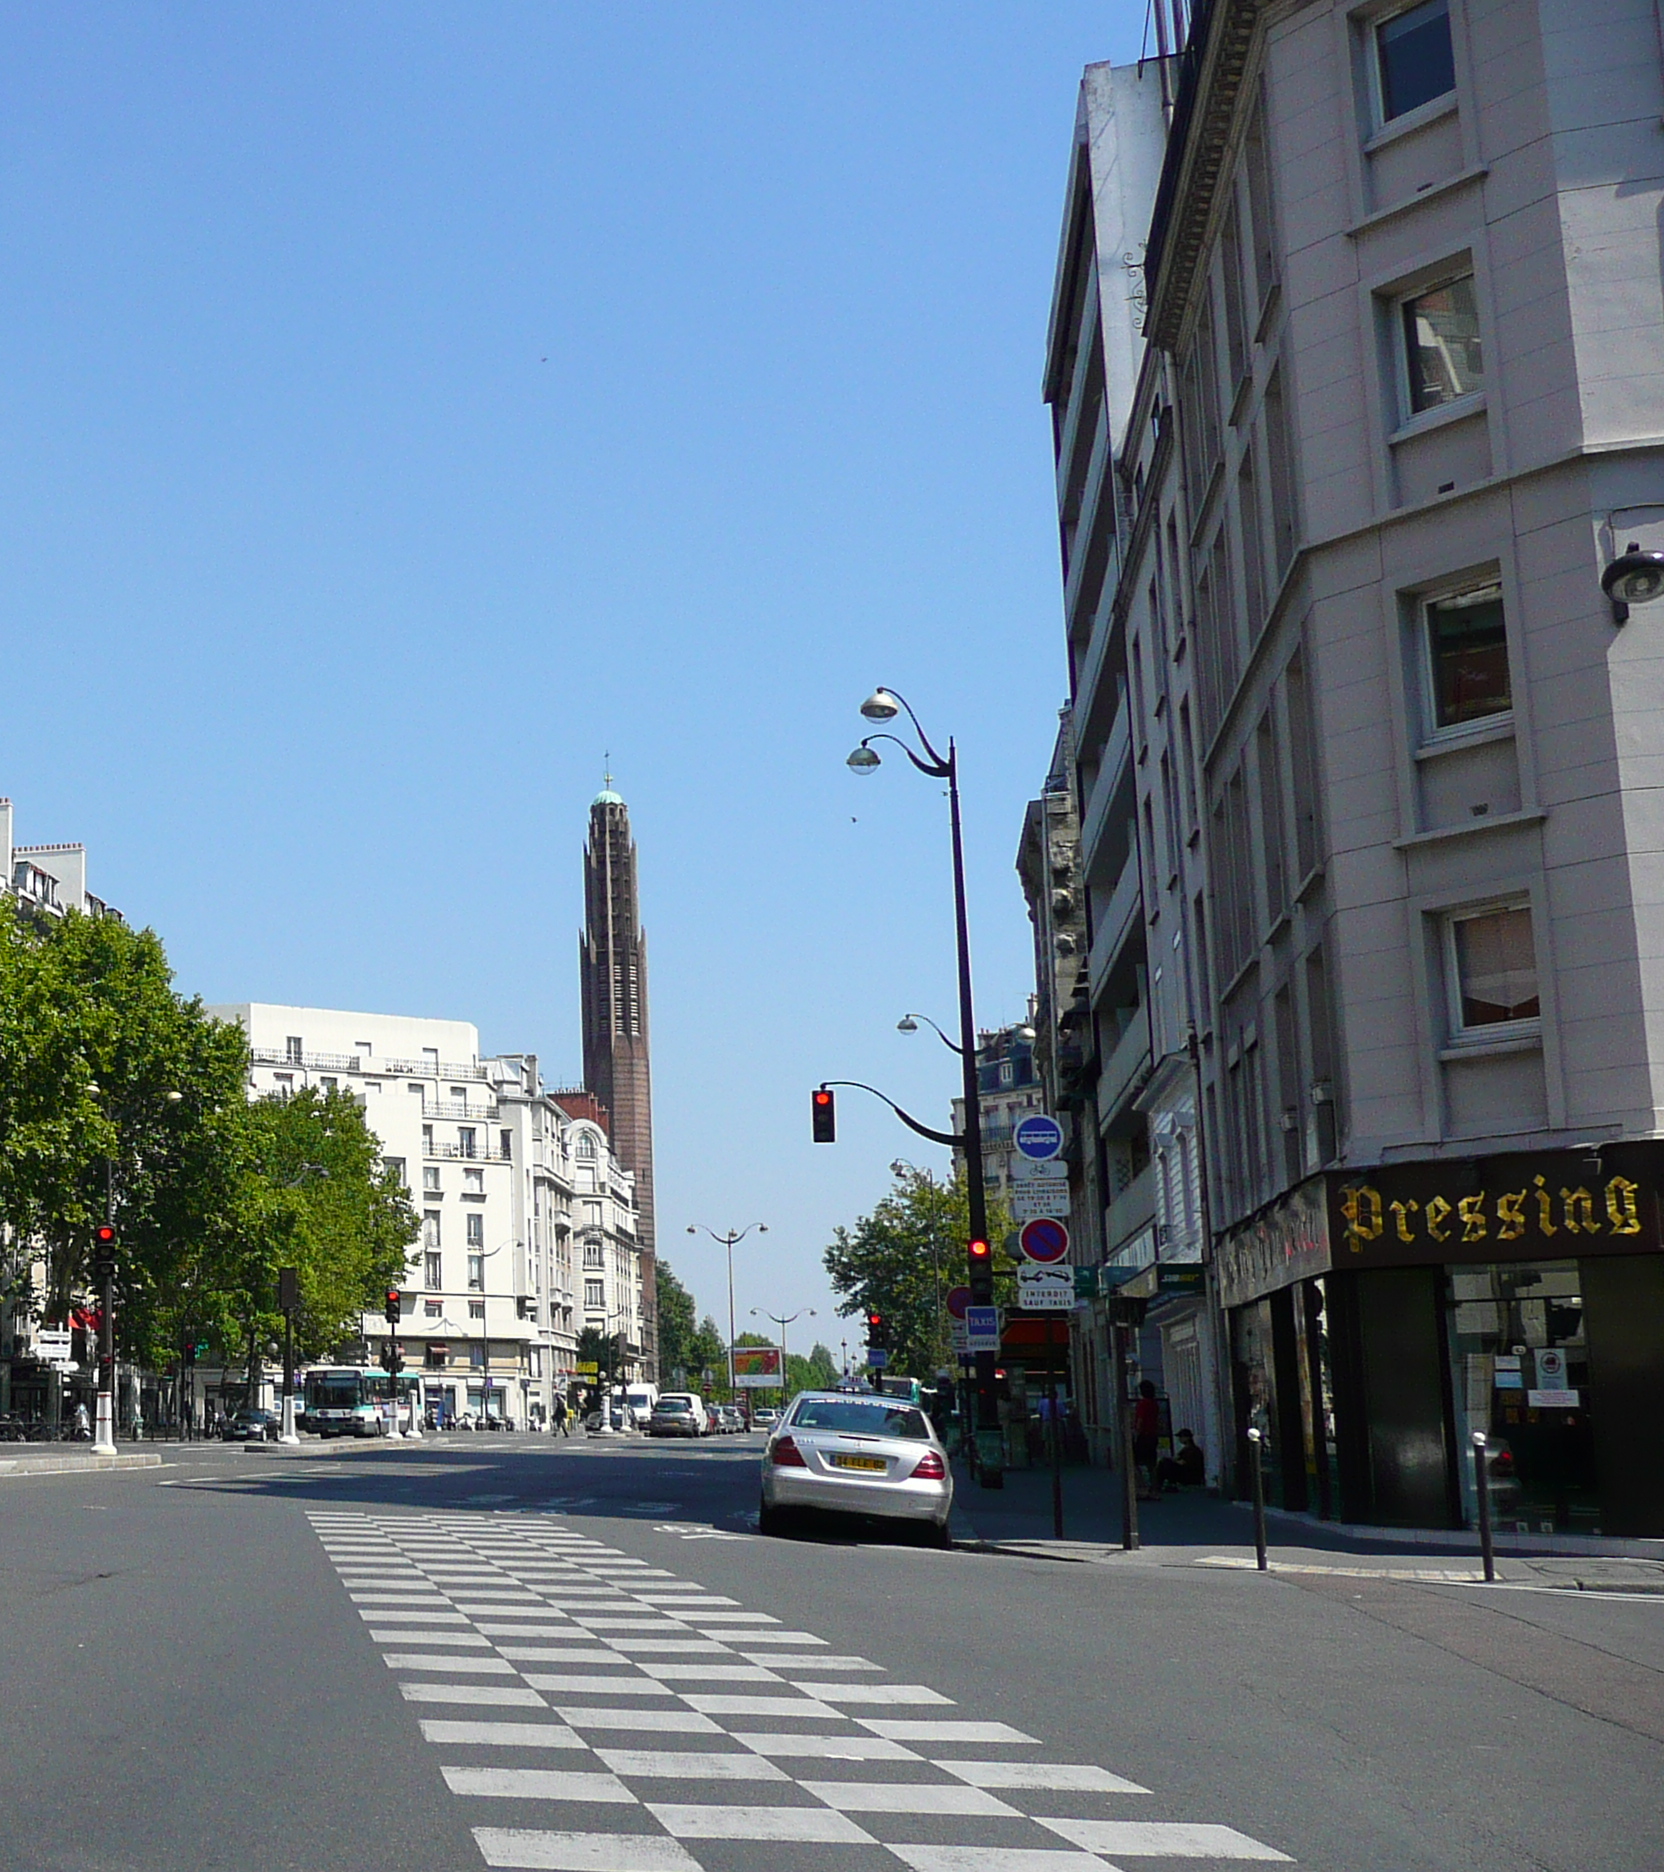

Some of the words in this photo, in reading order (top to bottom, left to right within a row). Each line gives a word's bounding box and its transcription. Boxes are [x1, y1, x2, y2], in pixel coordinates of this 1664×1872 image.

[1339, 1173, 1642, 1253] Pressing
[1025, 1290, 1068, 1298] INTERDIT
[969, 1317, 996, 1327] TAXIS
